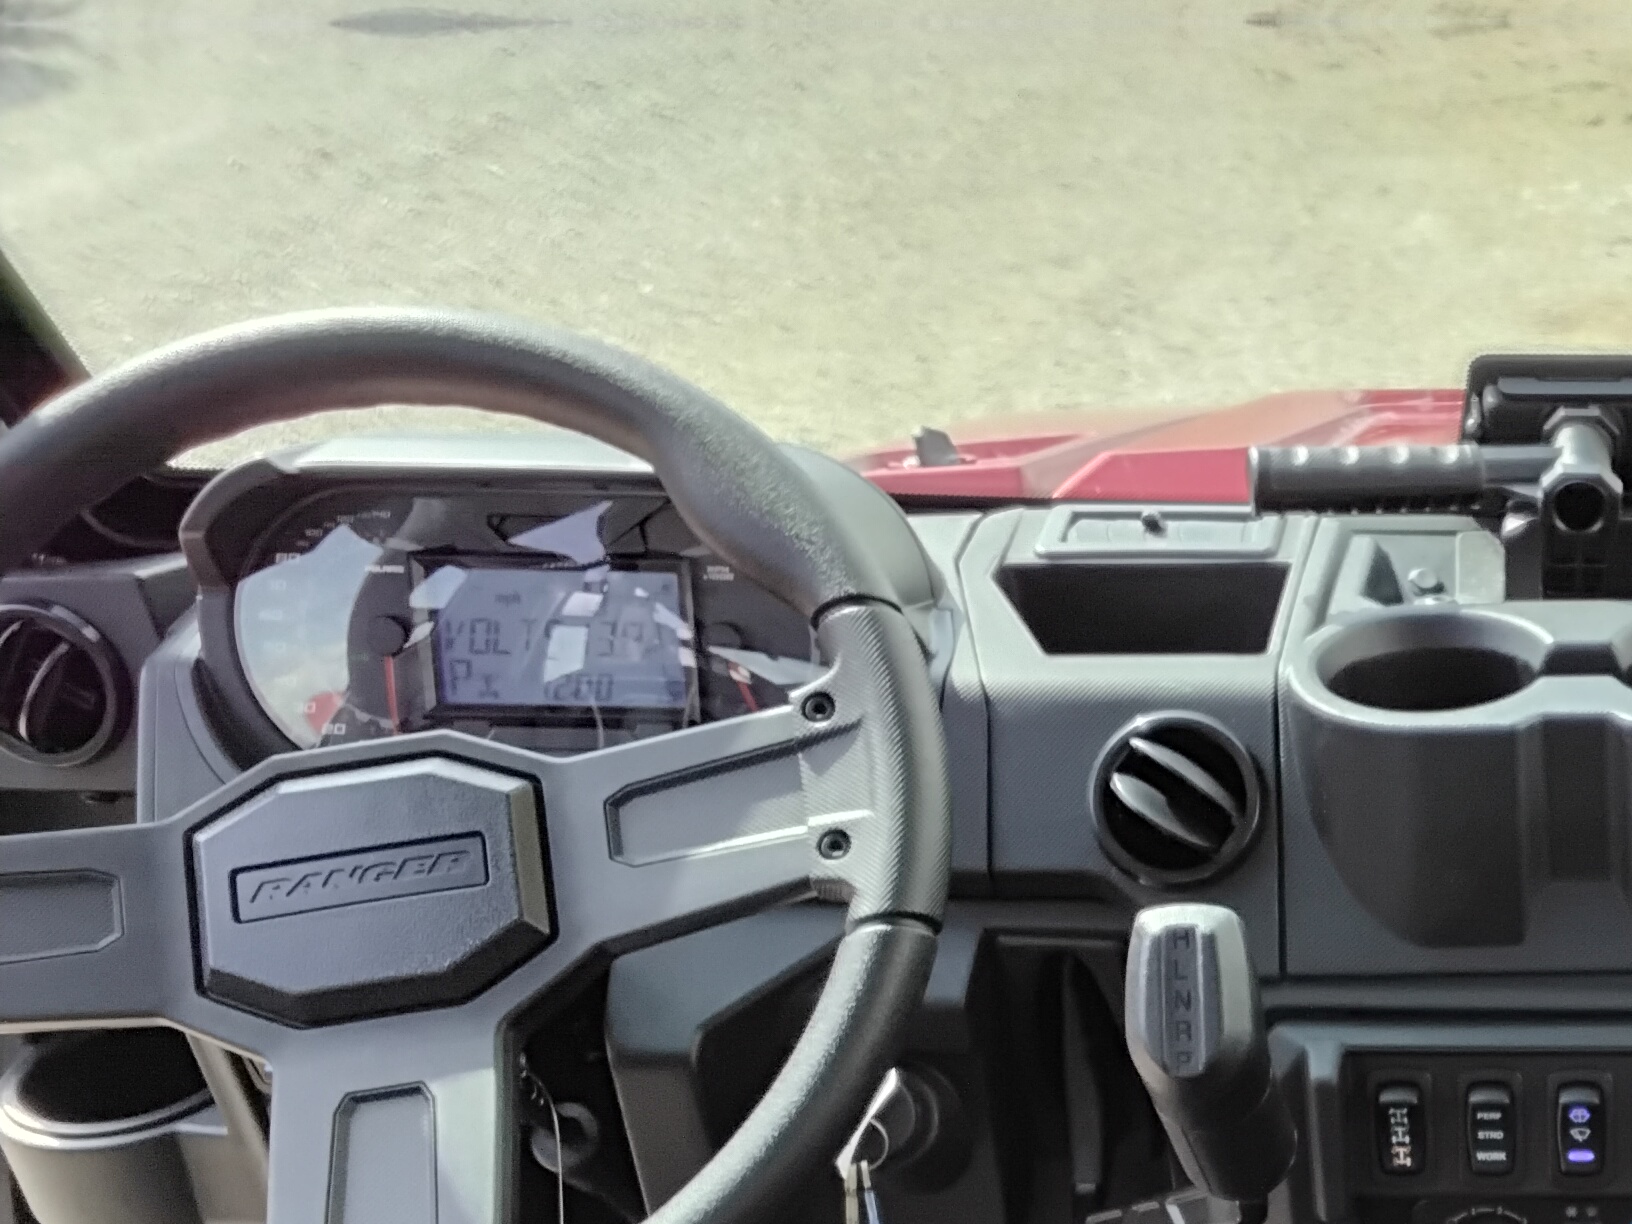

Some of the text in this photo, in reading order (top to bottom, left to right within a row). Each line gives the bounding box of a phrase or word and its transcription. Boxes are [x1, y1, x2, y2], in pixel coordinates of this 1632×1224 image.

[249, 849, 472, 904] RANGER
[1173, 929, 1190, 949] H
[1174, 959, 1189, 980] L
[1174, 989, 1192, 1012] N
[1175, 1020, 1192, 1041] R
[1476, 1151, 1507, 1161] WORK
